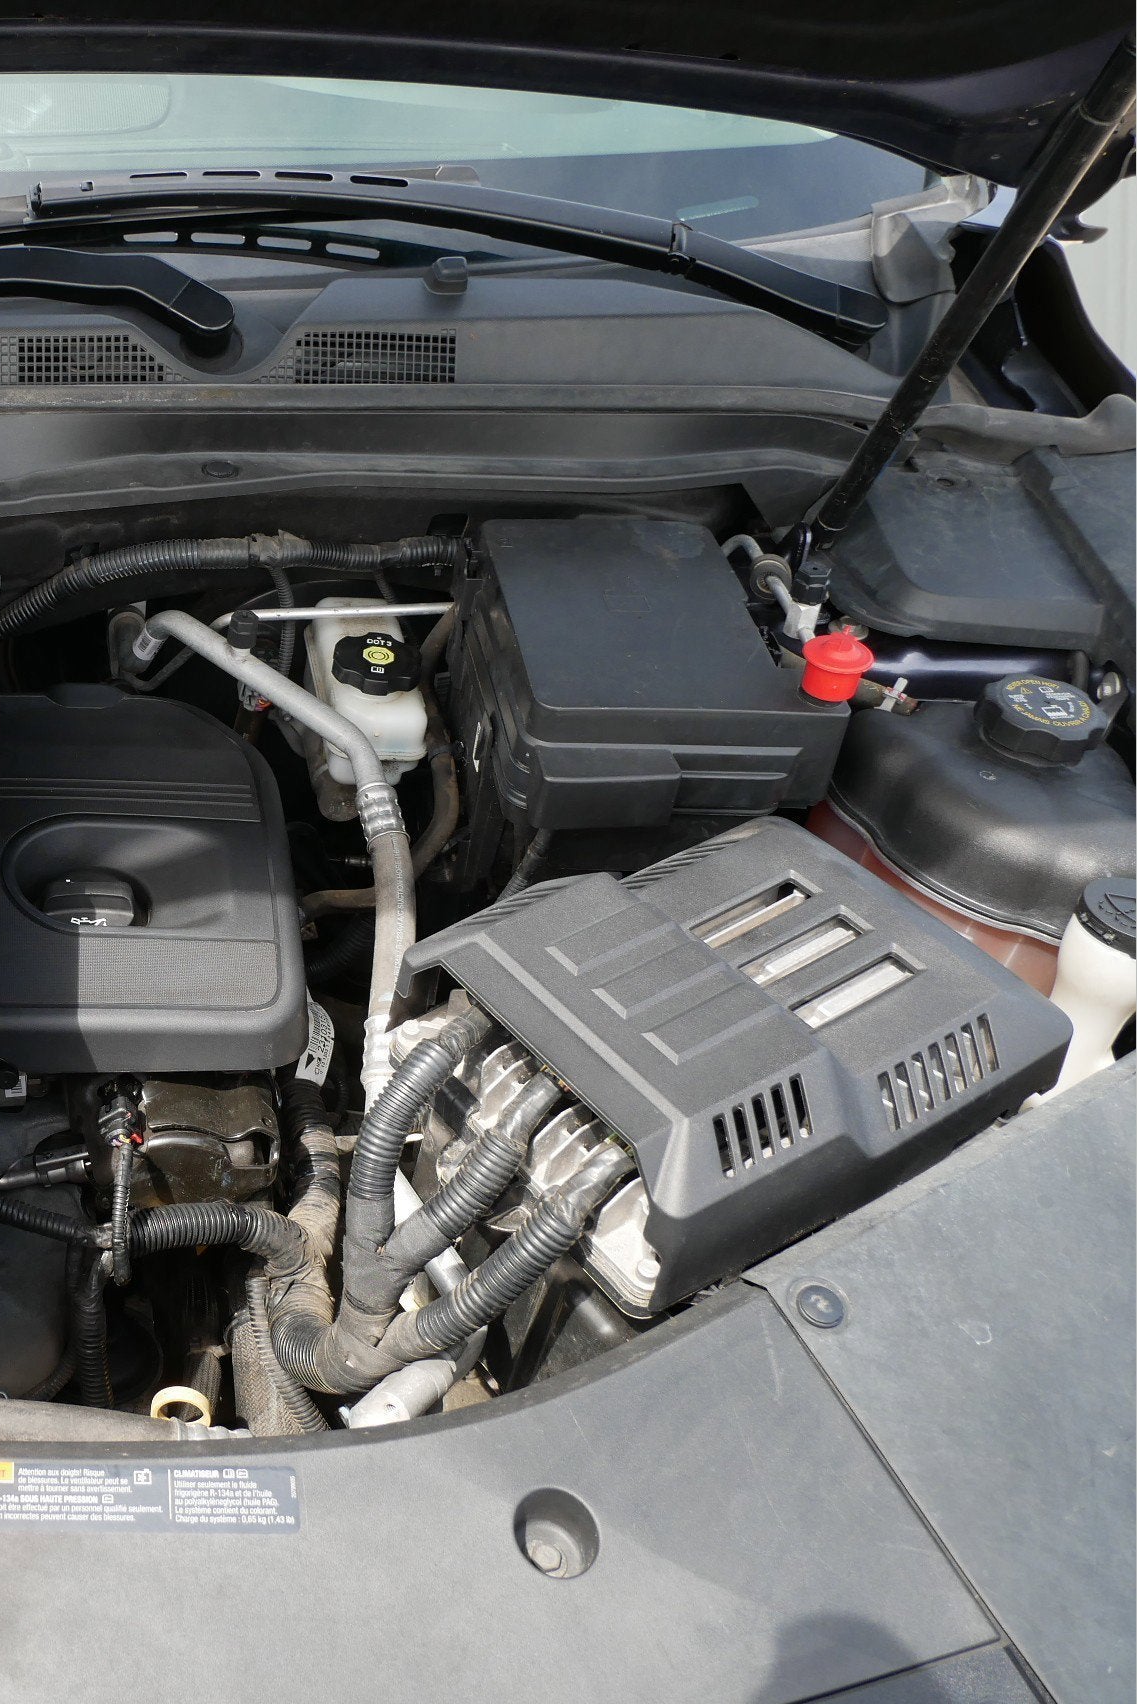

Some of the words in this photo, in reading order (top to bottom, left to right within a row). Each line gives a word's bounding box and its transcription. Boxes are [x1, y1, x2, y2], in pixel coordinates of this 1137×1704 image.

[366, 638, 386, 646] DOT
[396, 879, 404, 908] SUCTION
[83, 1469, 105, 1477] Risque
[174, 1469, 219, 1478] CLIMATISEUR
[174, 1480, 195, 1488] Utiliser
[239, 1480, 257, 1489] fluide
[174, 1489, 209, 1498] frigorigène
[210, 1489, 234, 1497] R-134a
[243, 1489, 251, 1497] de
[253, 1489, 272, 1497] l'huile
[20, 1494, 39, 1502] SOUS
[40, 1495, 63, 1503] HAUTE
[64, 1495, 98, 1503] PRESSION
